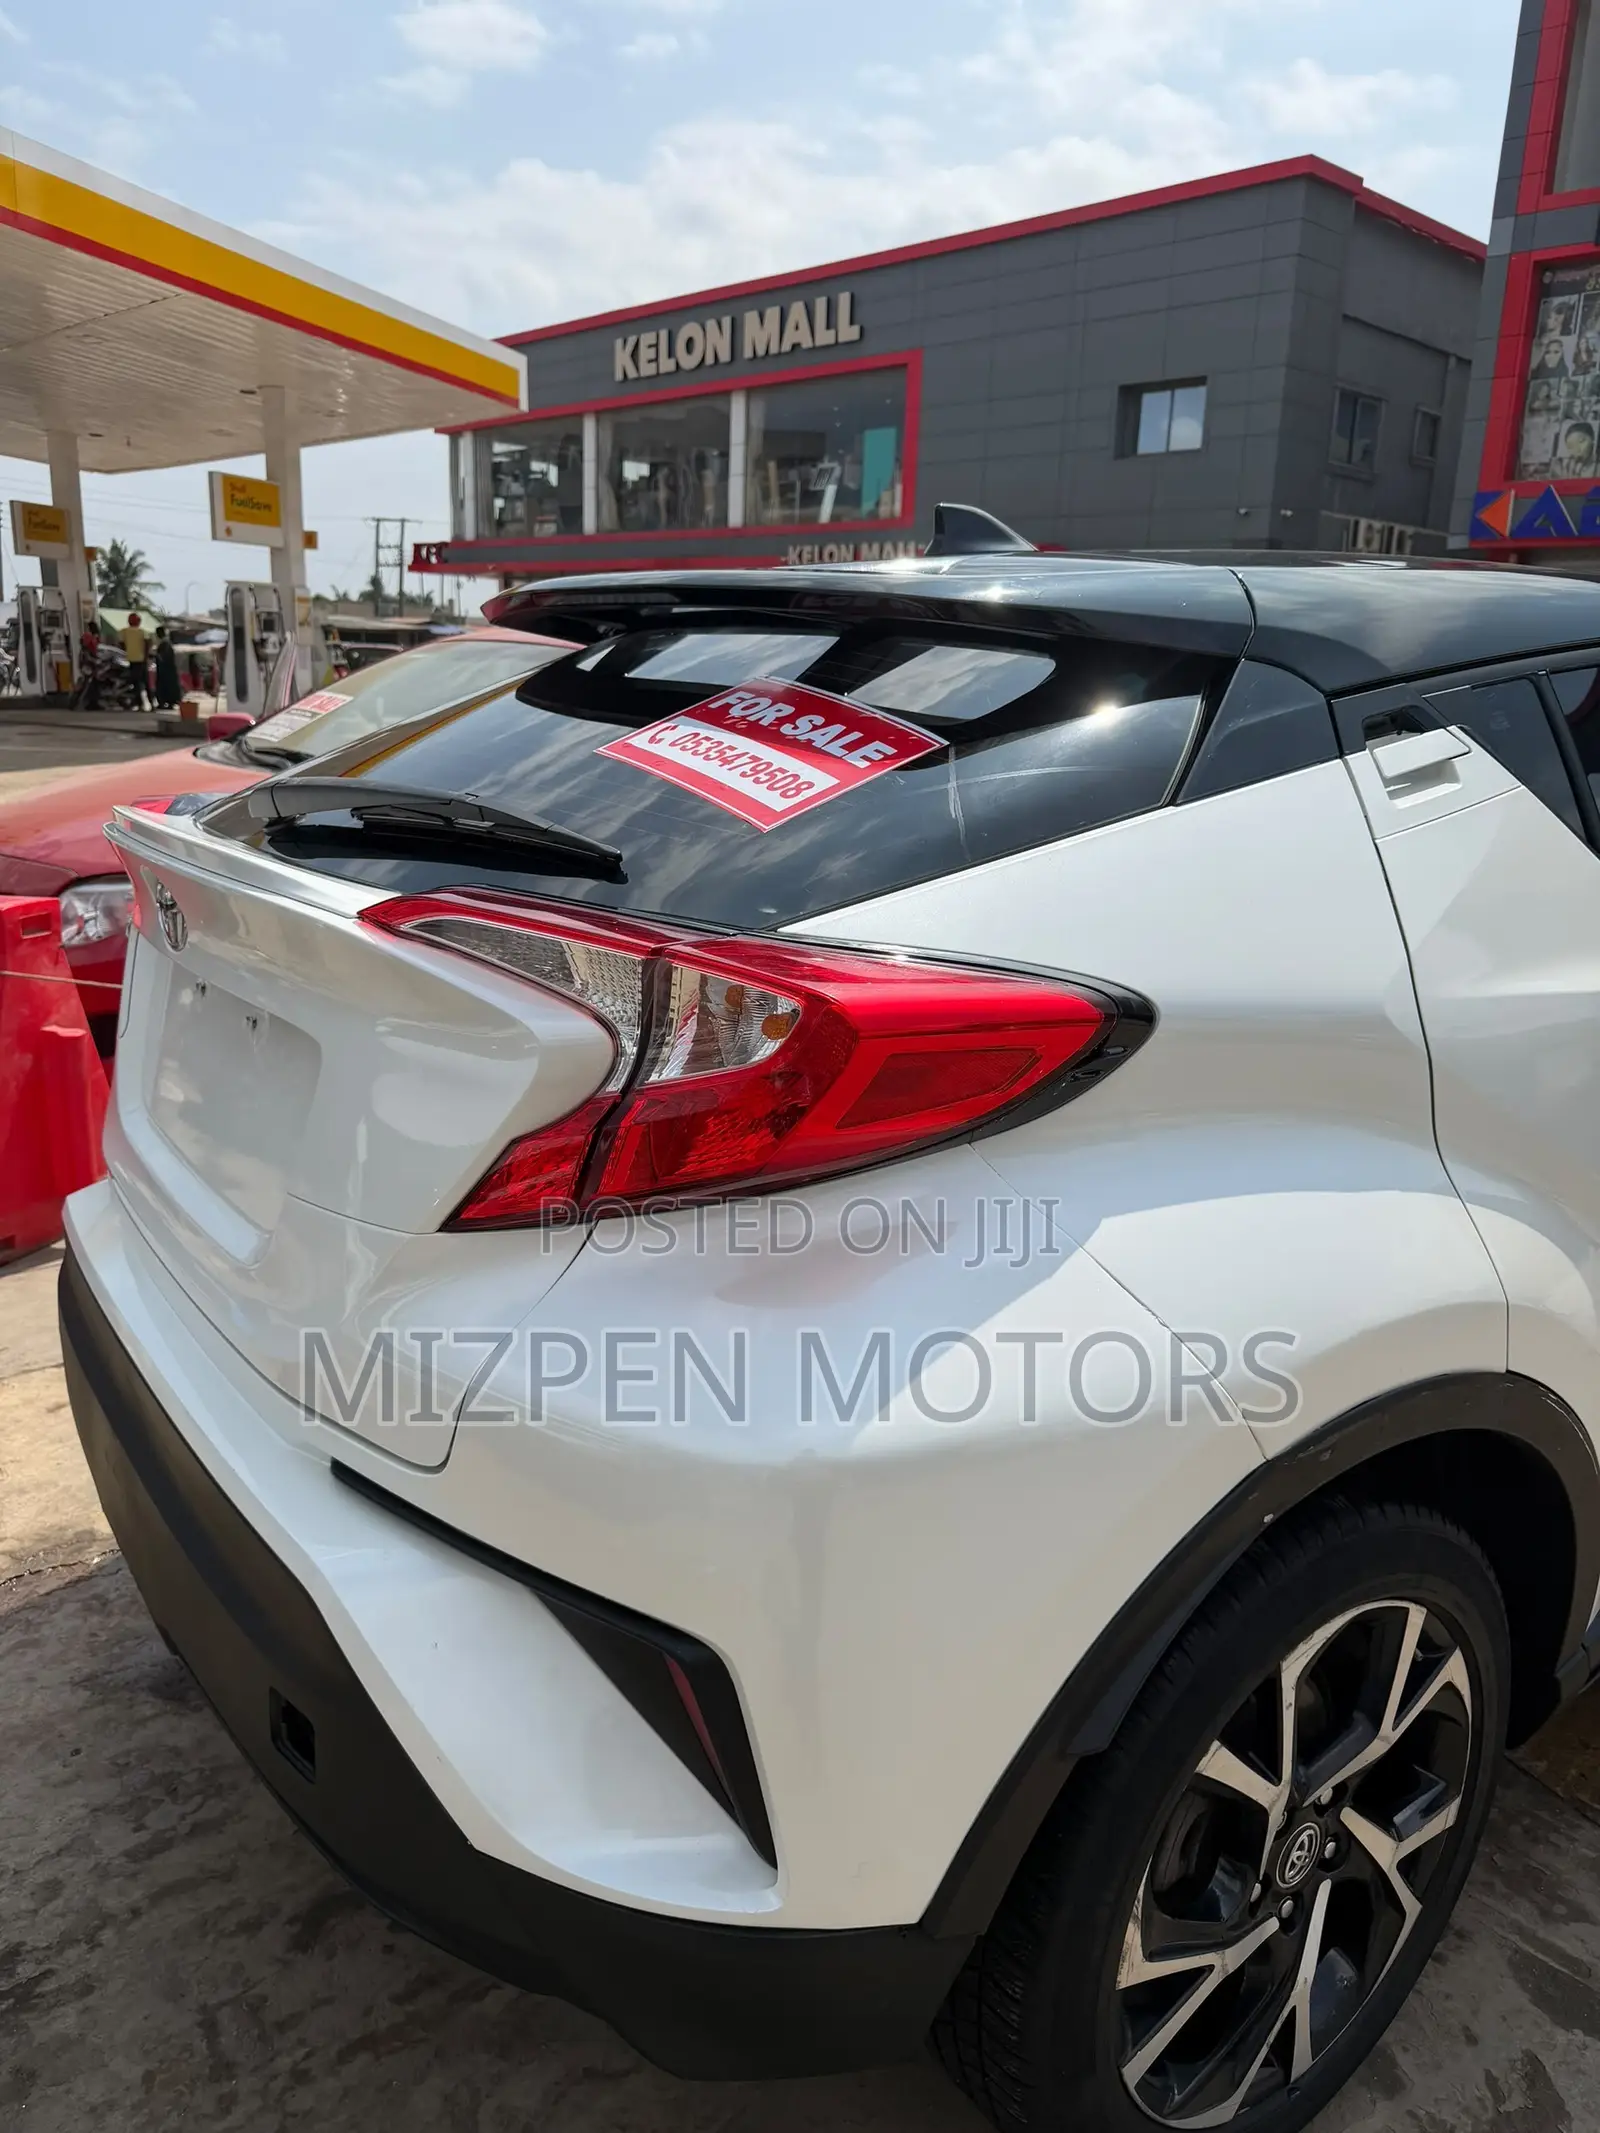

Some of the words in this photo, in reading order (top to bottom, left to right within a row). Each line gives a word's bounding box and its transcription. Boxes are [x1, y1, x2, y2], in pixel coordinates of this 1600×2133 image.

[614, 315, 733, 382] KELON
[743, 291, 862, 360] MALL
[788, 543, 855, 566] KELON
[668, 730, 816, 800] 0535479508
[708, 690, 796, 726] FOR
[779, 714, 899, 770] SALE
